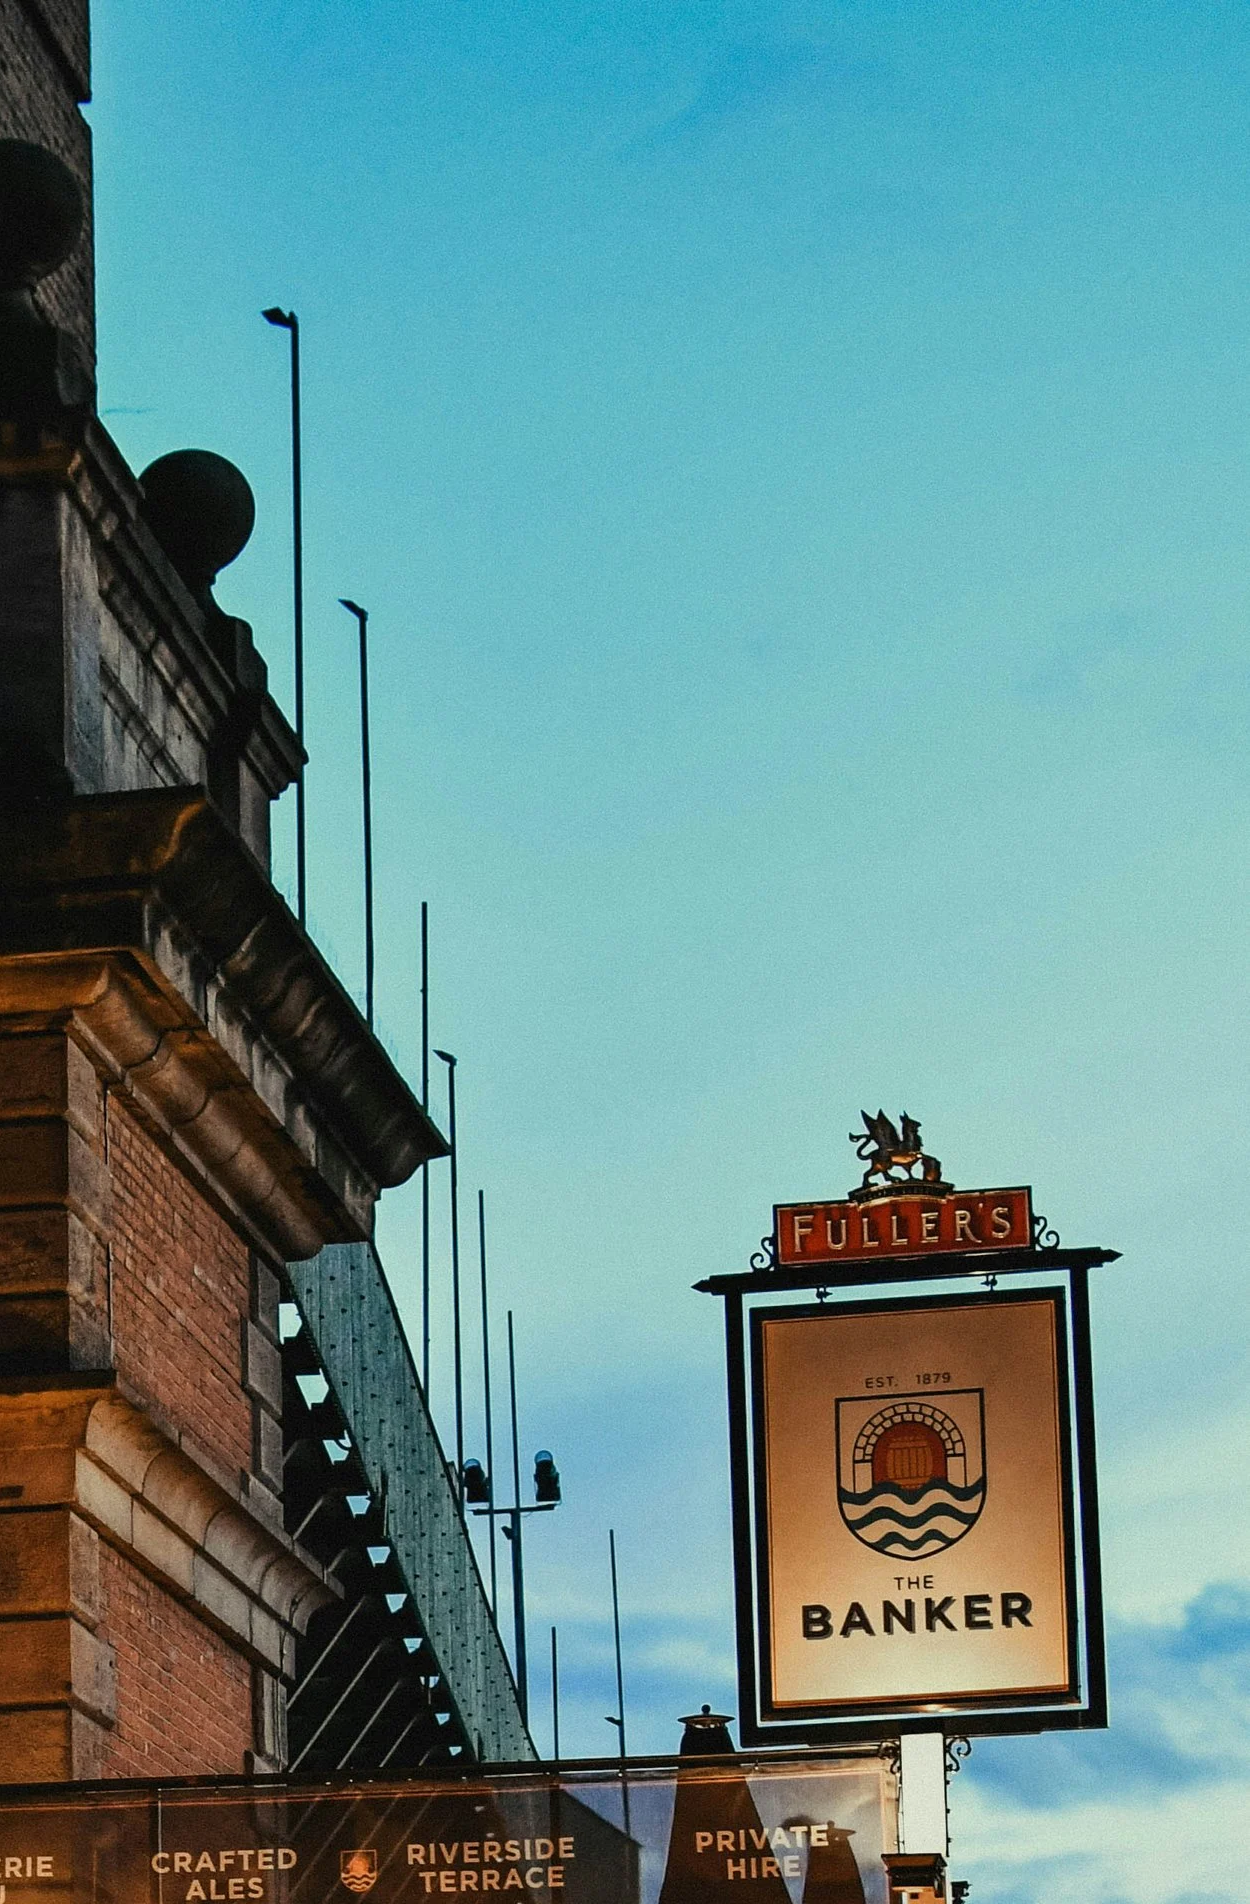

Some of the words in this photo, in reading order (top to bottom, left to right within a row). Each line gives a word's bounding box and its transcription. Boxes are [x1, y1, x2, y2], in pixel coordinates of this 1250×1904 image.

[793, 1202, 1012, 1253] FULLER'S
[864, 1375, 899, 1389] EST.
[915, 1372, 951, 1385] 1879
[893, 1575, 935, 1590] THE
[802, 1592, 1034, 1641] BANKER
[406, 1836, 576, 1866] RIVERSIDE
[695, 1824, 830, 1854] PRIVATE
[151, 1847, 298, 1874] CRAFTED
[726, 1855, 801, 1880] HIRE
[185, 1876, 265, 1901] ALES
[418, 1865, 566, 1894] TERRACE
